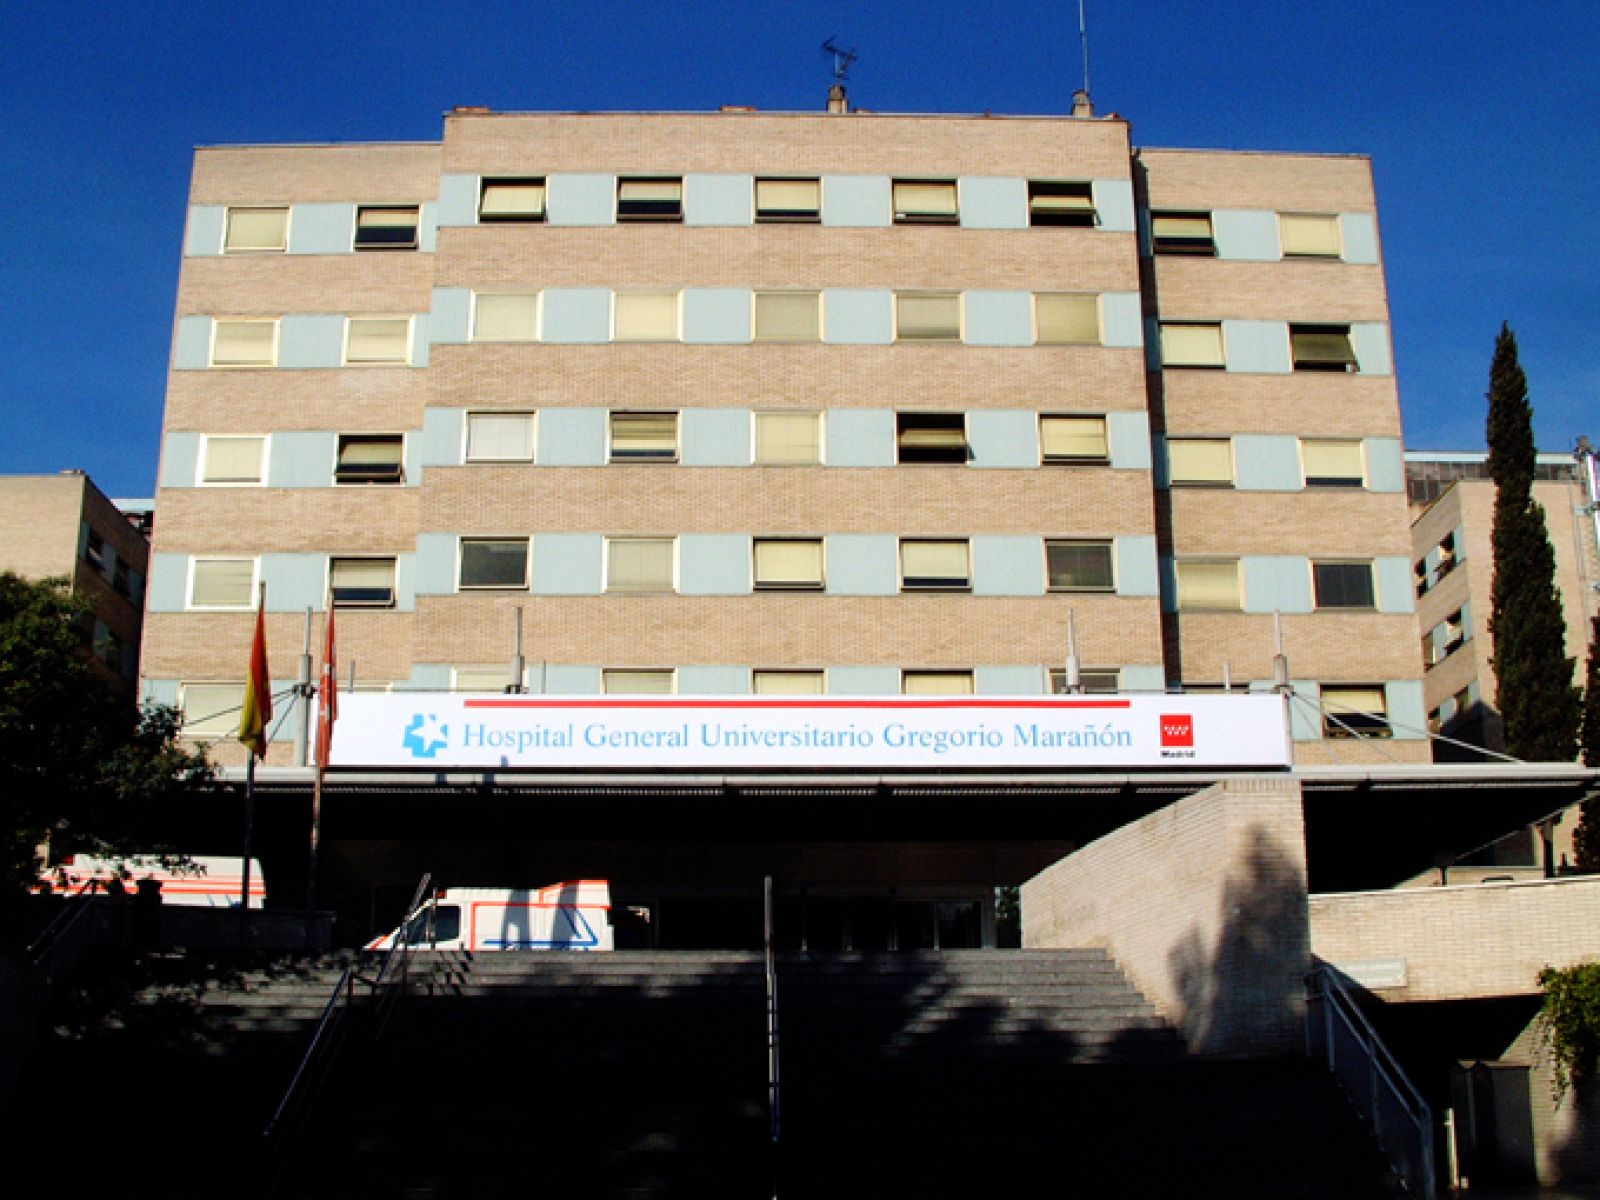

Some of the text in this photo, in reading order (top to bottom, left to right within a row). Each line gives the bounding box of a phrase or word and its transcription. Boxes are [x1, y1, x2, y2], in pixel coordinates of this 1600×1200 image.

[463, 722, 1133, 753] Hospital General Universitario Gregorio Marañón
[1160, 750, 1195, 758] Madrid
